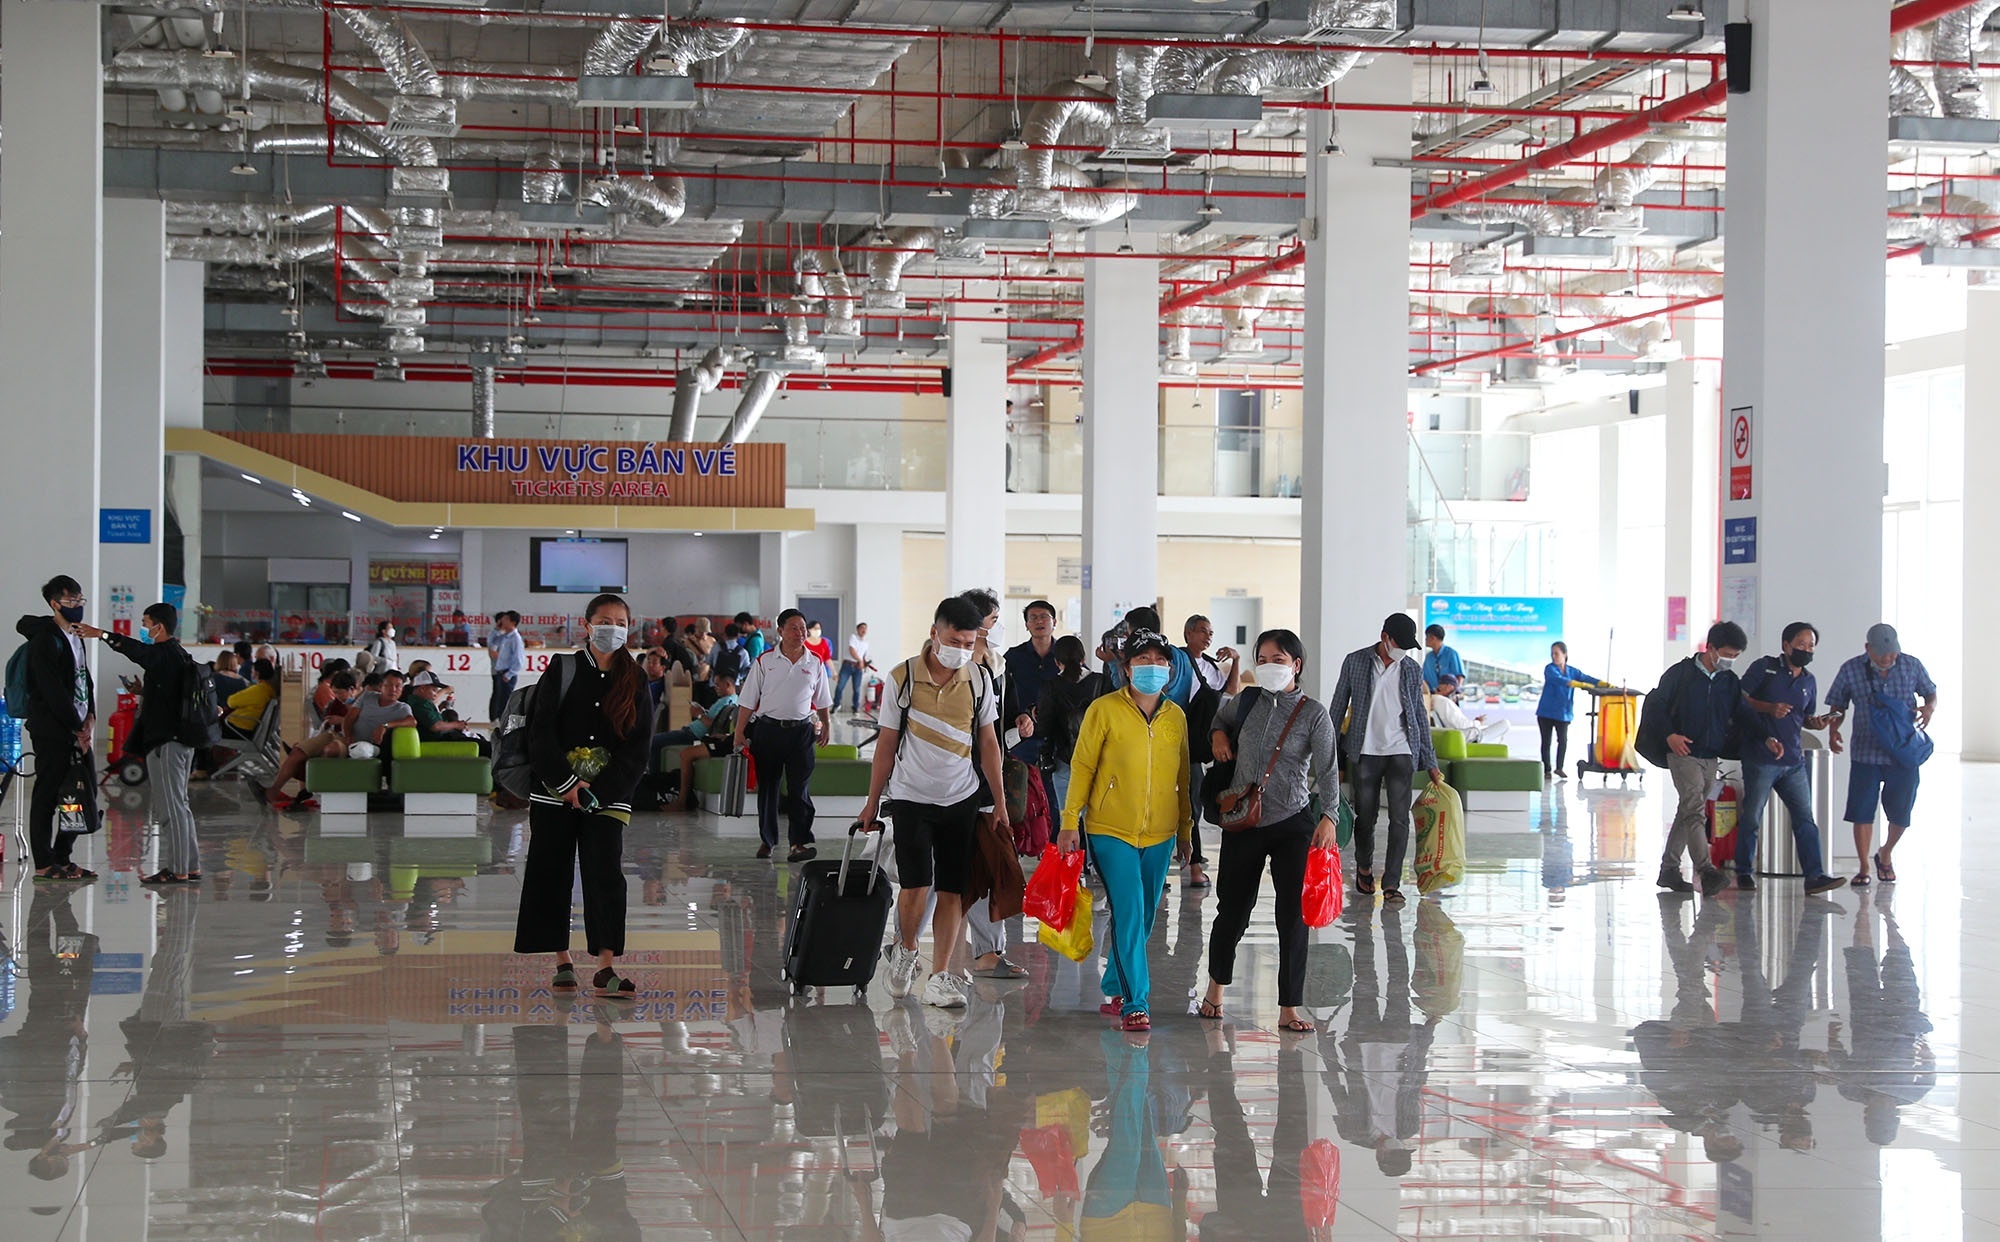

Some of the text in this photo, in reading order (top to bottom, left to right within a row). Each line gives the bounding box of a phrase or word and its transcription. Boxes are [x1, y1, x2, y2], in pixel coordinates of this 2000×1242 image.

[457, 442, 737, 480] KHU VỰC BÁN VÉ
[512, 479, 670, 498] TICKETS AREA
[447, 654, 471, 671] 12
[526, 655, 549, 672] 13
